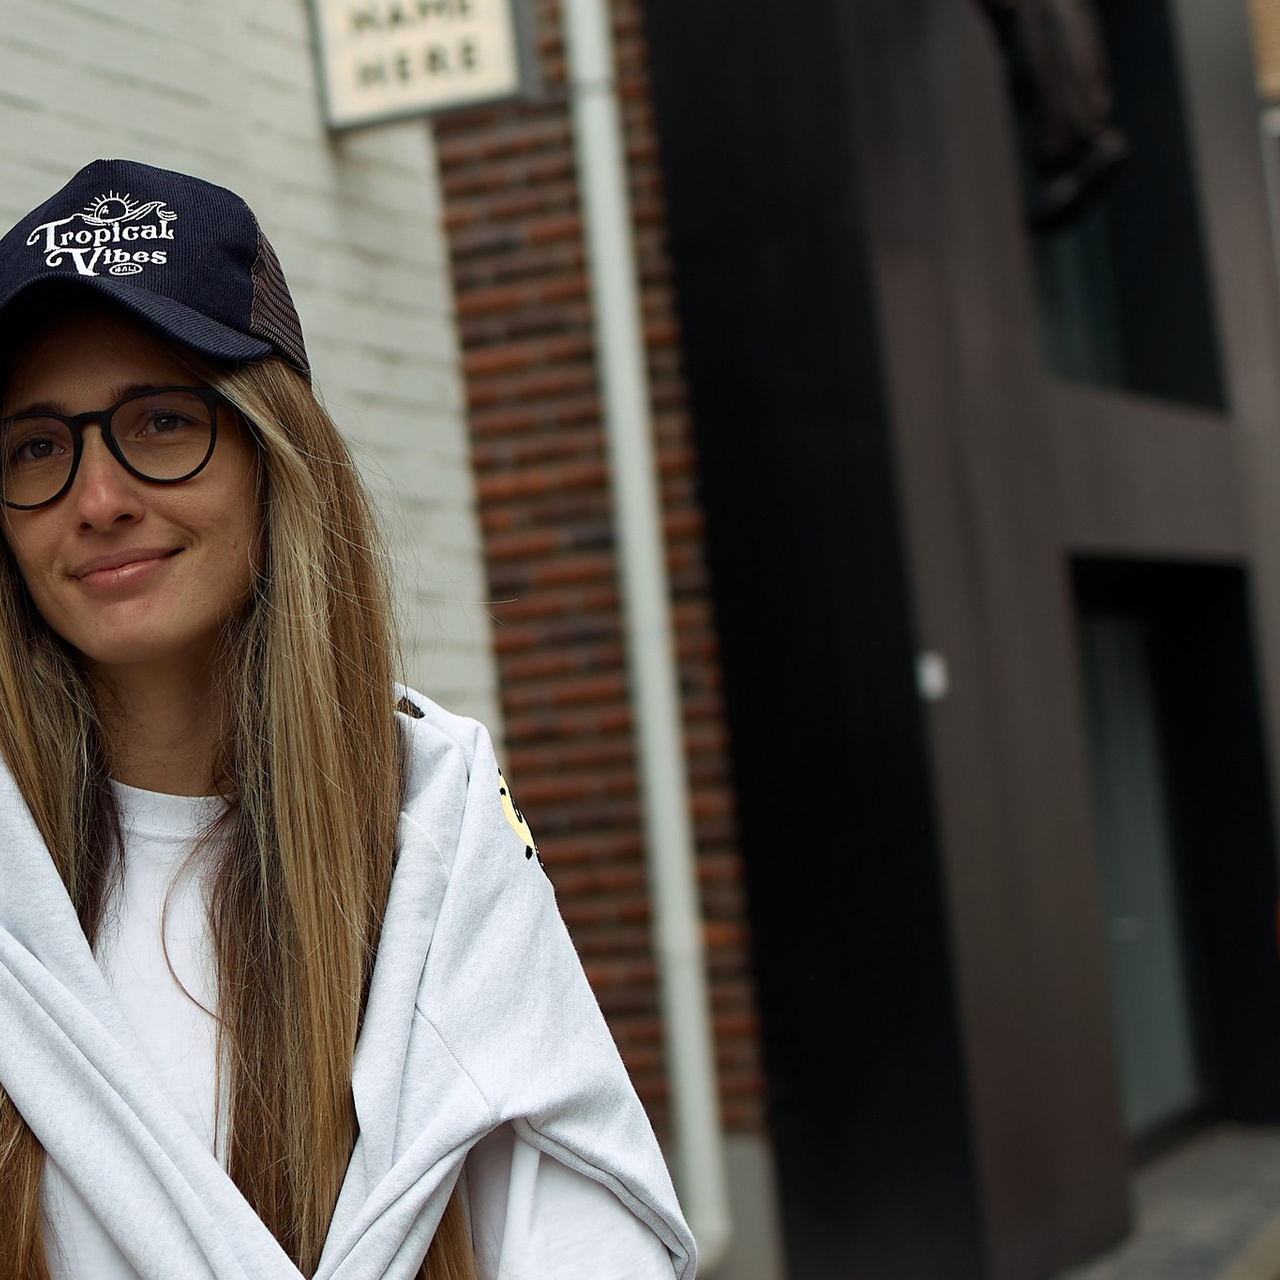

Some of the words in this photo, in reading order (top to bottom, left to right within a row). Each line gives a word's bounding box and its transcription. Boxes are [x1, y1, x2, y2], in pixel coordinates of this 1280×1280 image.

[355, 38, 479, 87] HERE
[26, 213, 175, 253] Tropical
[45, 246, 168, 276] Vibes
